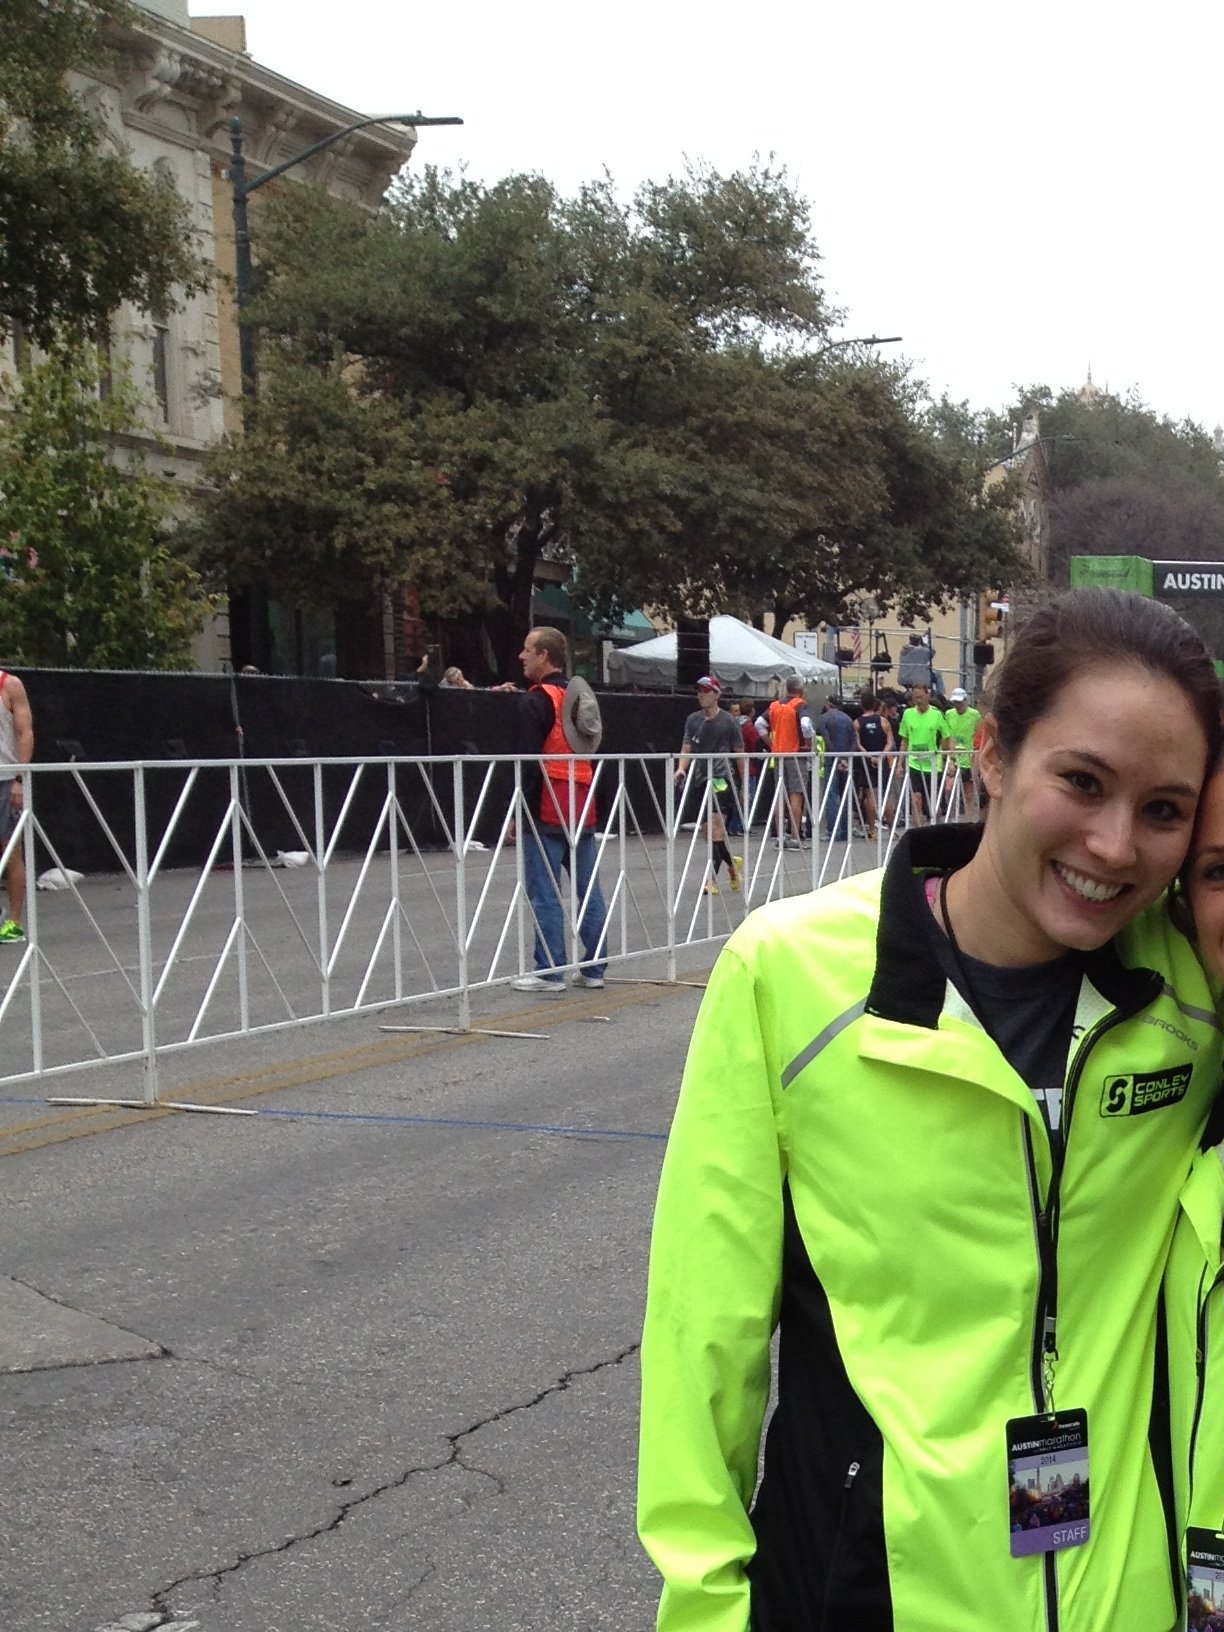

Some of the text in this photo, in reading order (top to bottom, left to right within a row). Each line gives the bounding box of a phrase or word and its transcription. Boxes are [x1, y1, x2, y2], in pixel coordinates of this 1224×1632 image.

[1144, 1014, 1199, 1052] BROOKS
[1134, 1072, 1190, 1095] CONLEY
[1133, 1085, 1187, 1107] SPORTS
[1053, 1526, 1087, 1545] STAFF
